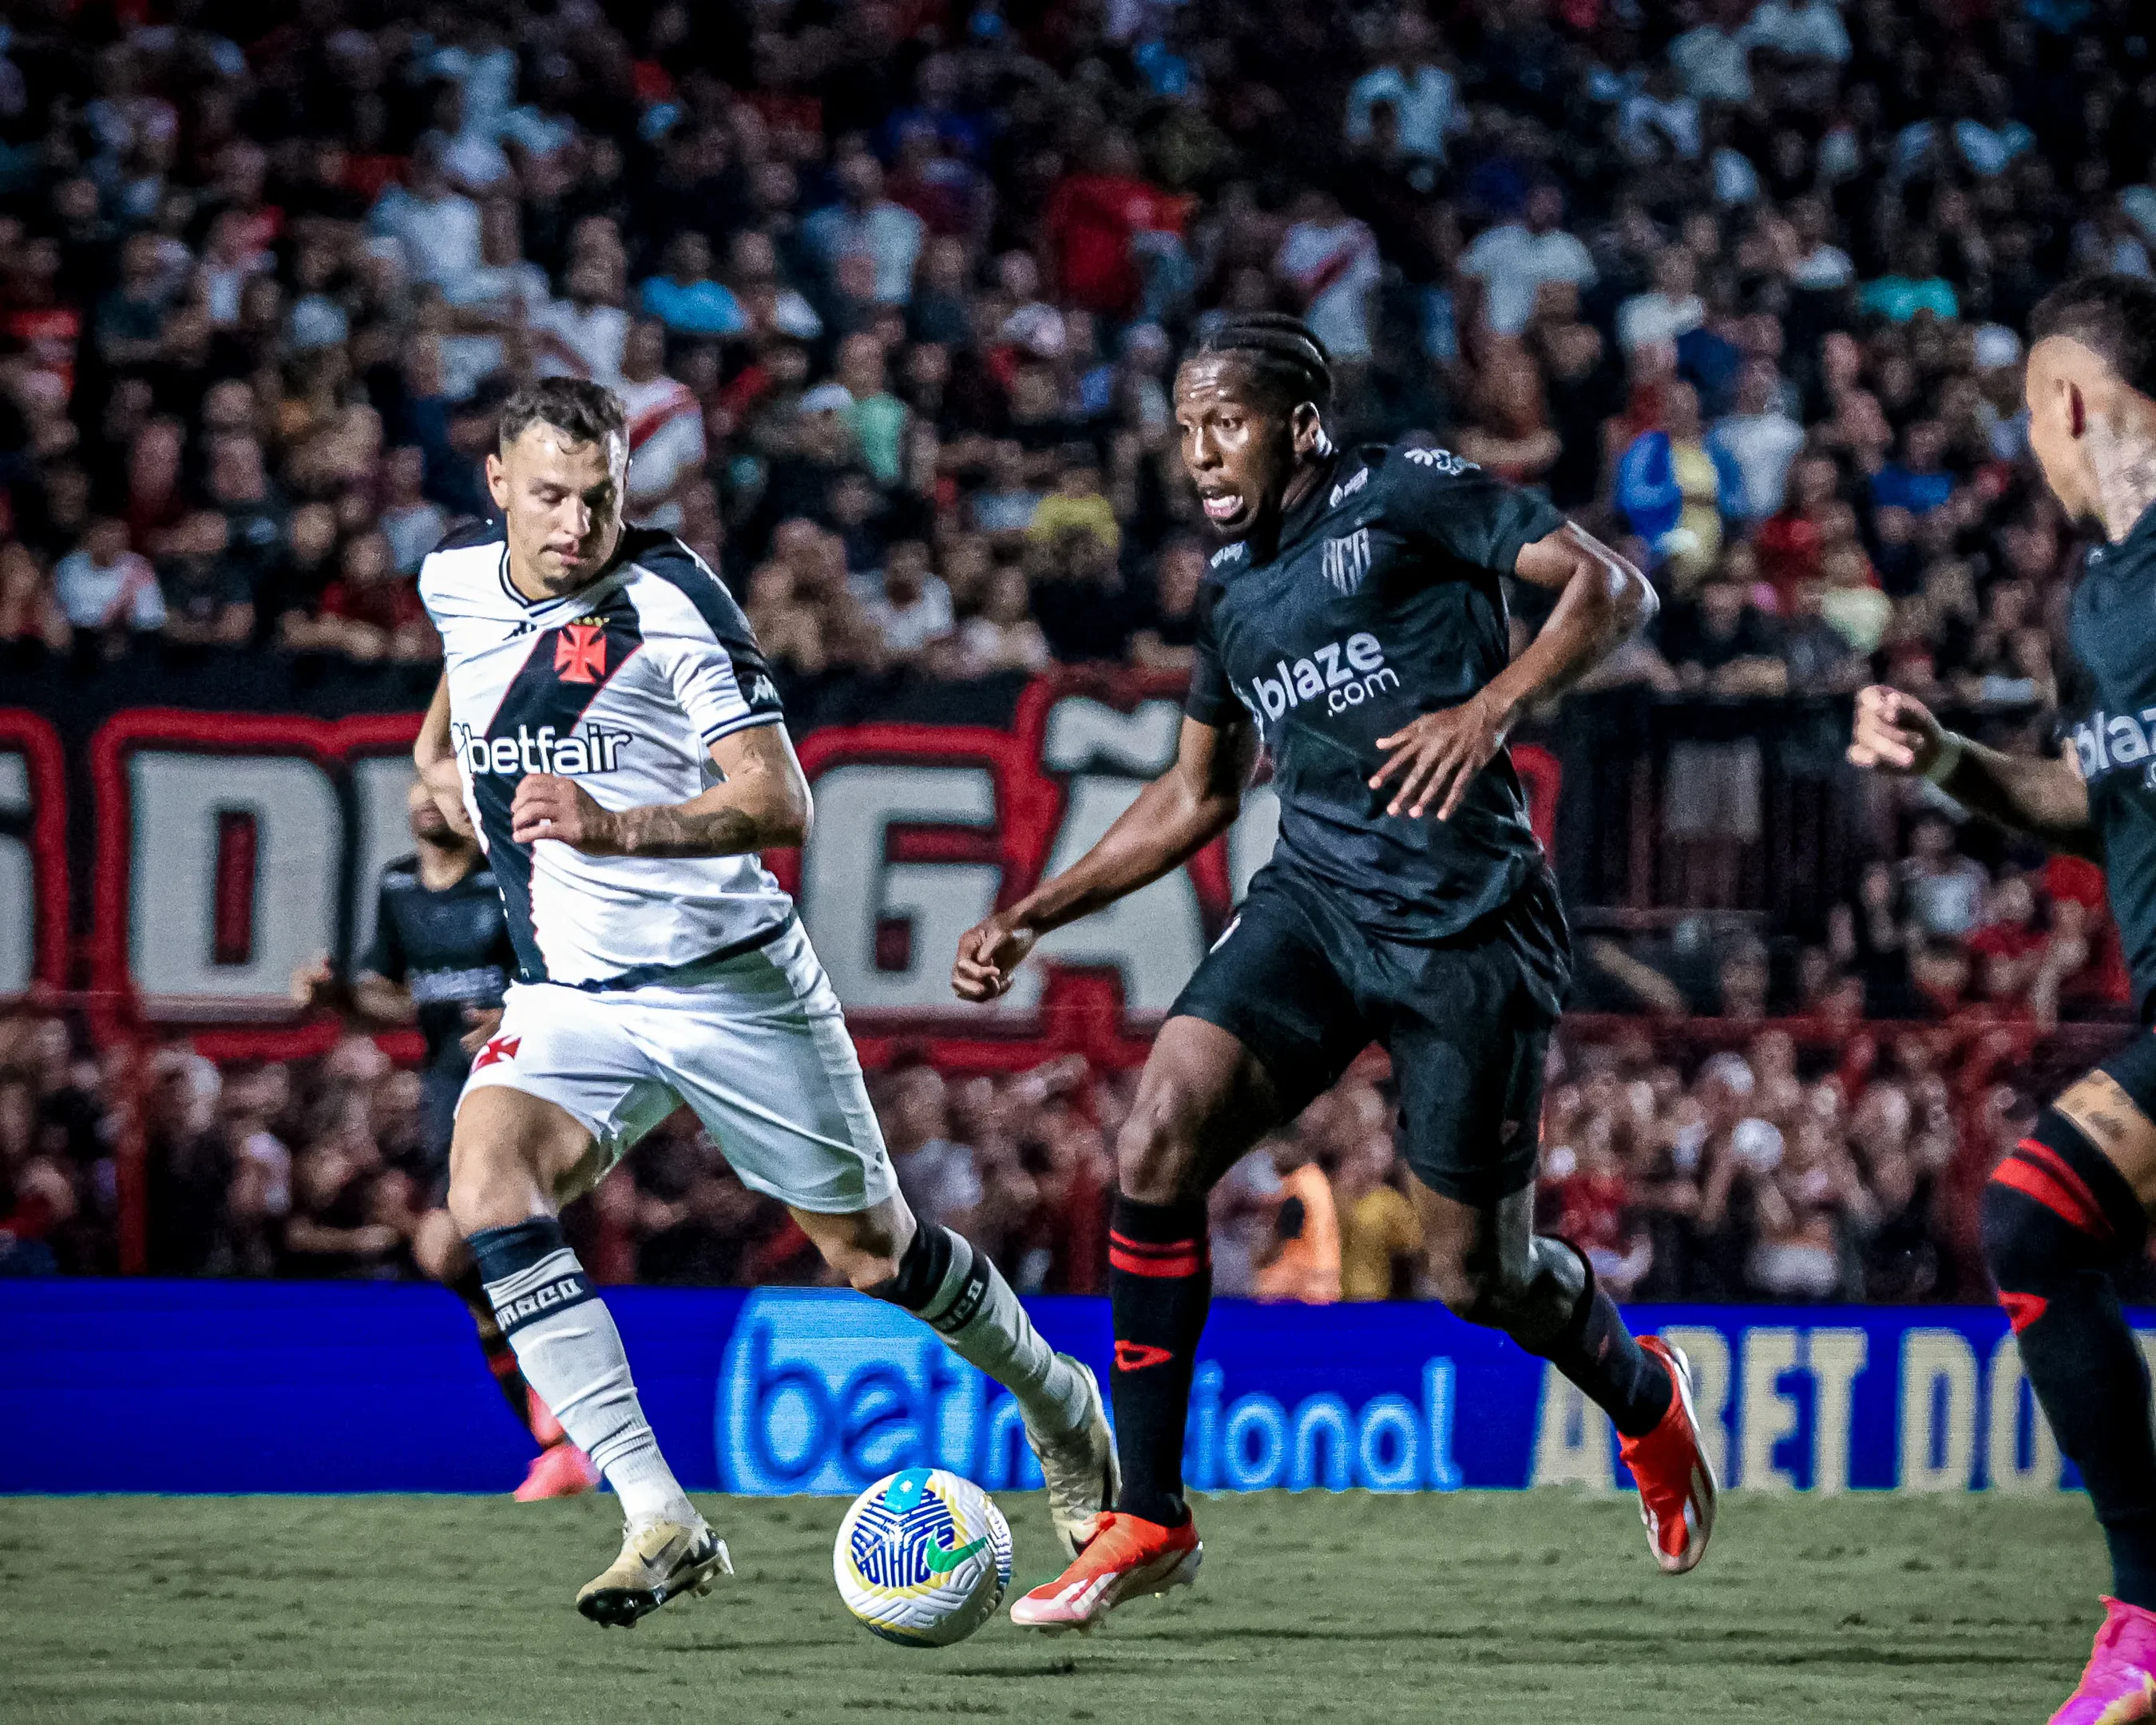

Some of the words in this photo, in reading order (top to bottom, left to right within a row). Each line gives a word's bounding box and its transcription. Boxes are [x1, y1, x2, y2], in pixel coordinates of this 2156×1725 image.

[1252, 632, 1385, 722] blaze
[1327, 668, 1400, 717] .com
[462, 722, 633, 775] betfair
